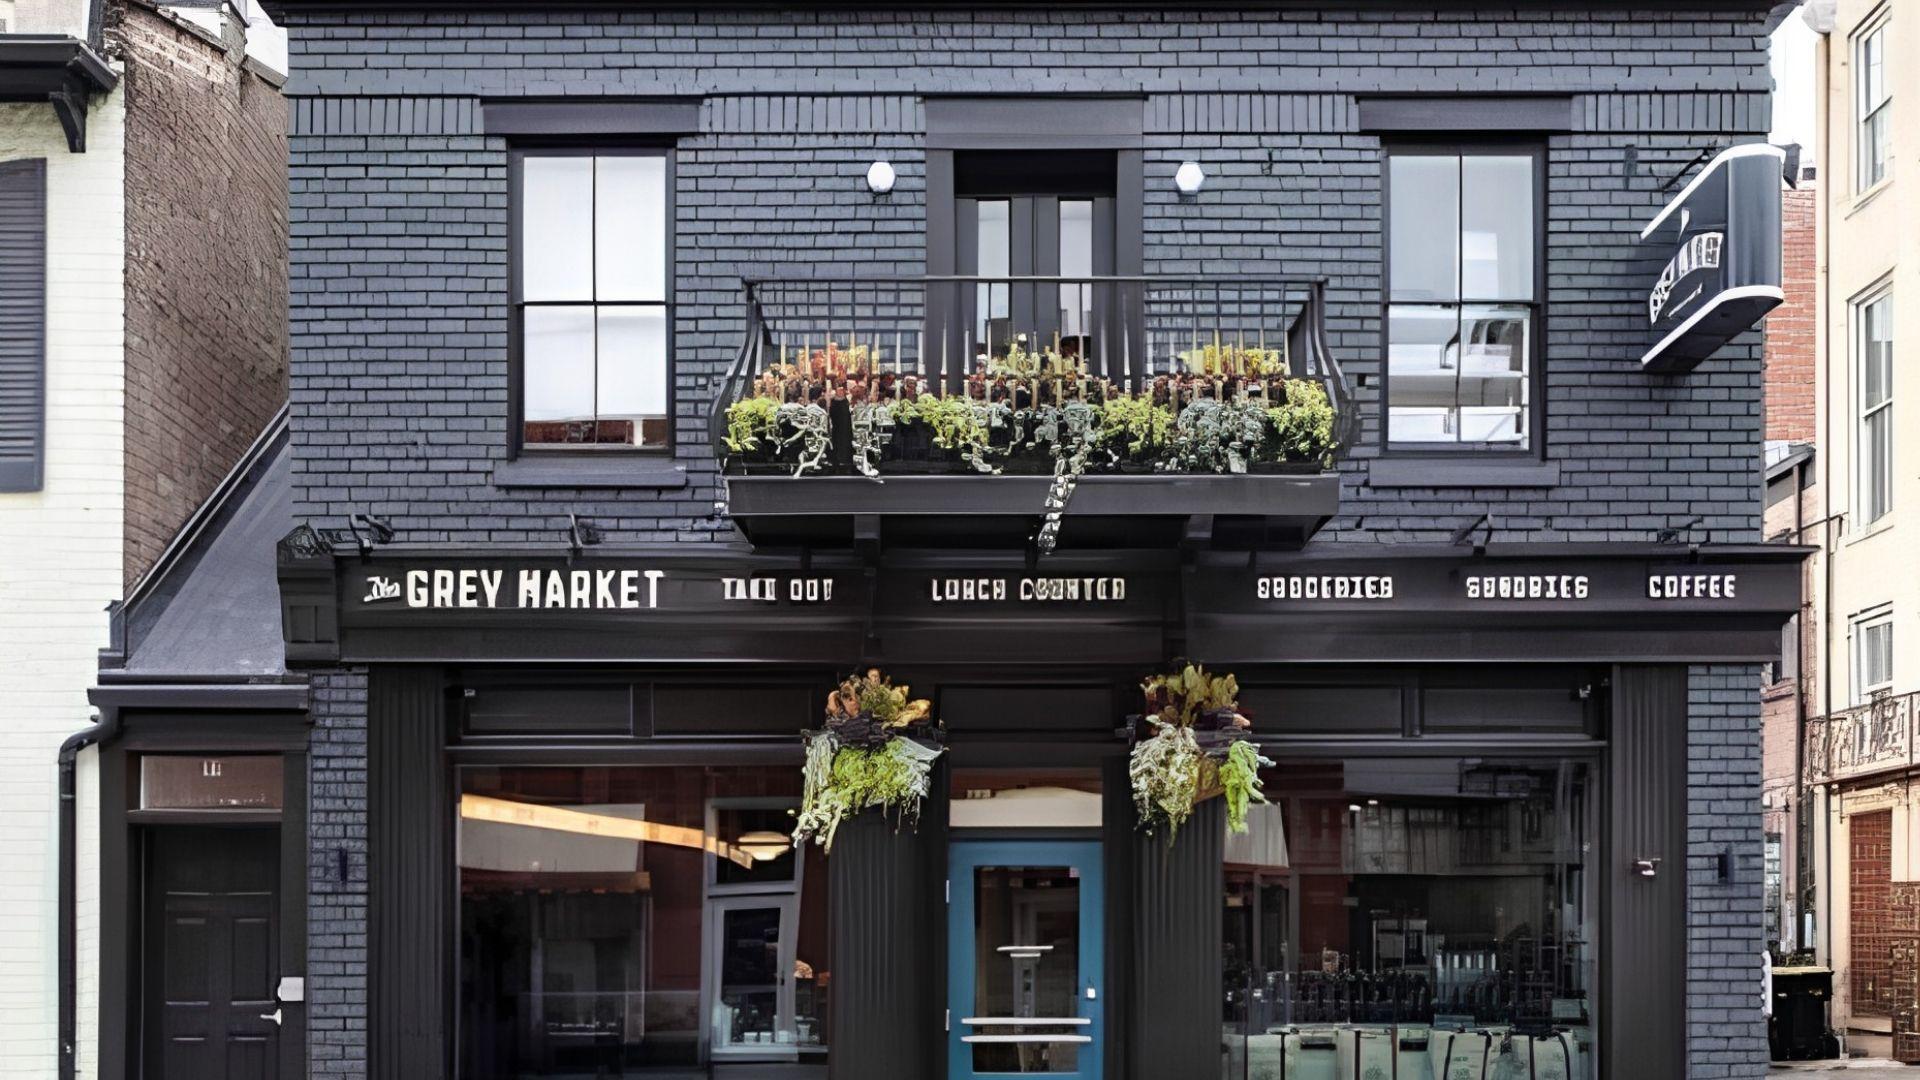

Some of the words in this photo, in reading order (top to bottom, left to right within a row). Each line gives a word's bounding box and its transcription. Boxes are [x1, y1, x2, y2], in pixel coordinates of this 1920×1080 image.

[406, 569, 503, 608] GREY
[518, 569, 666, 608] MARKET
[1648, 574, 1737, 598] COFFEE
